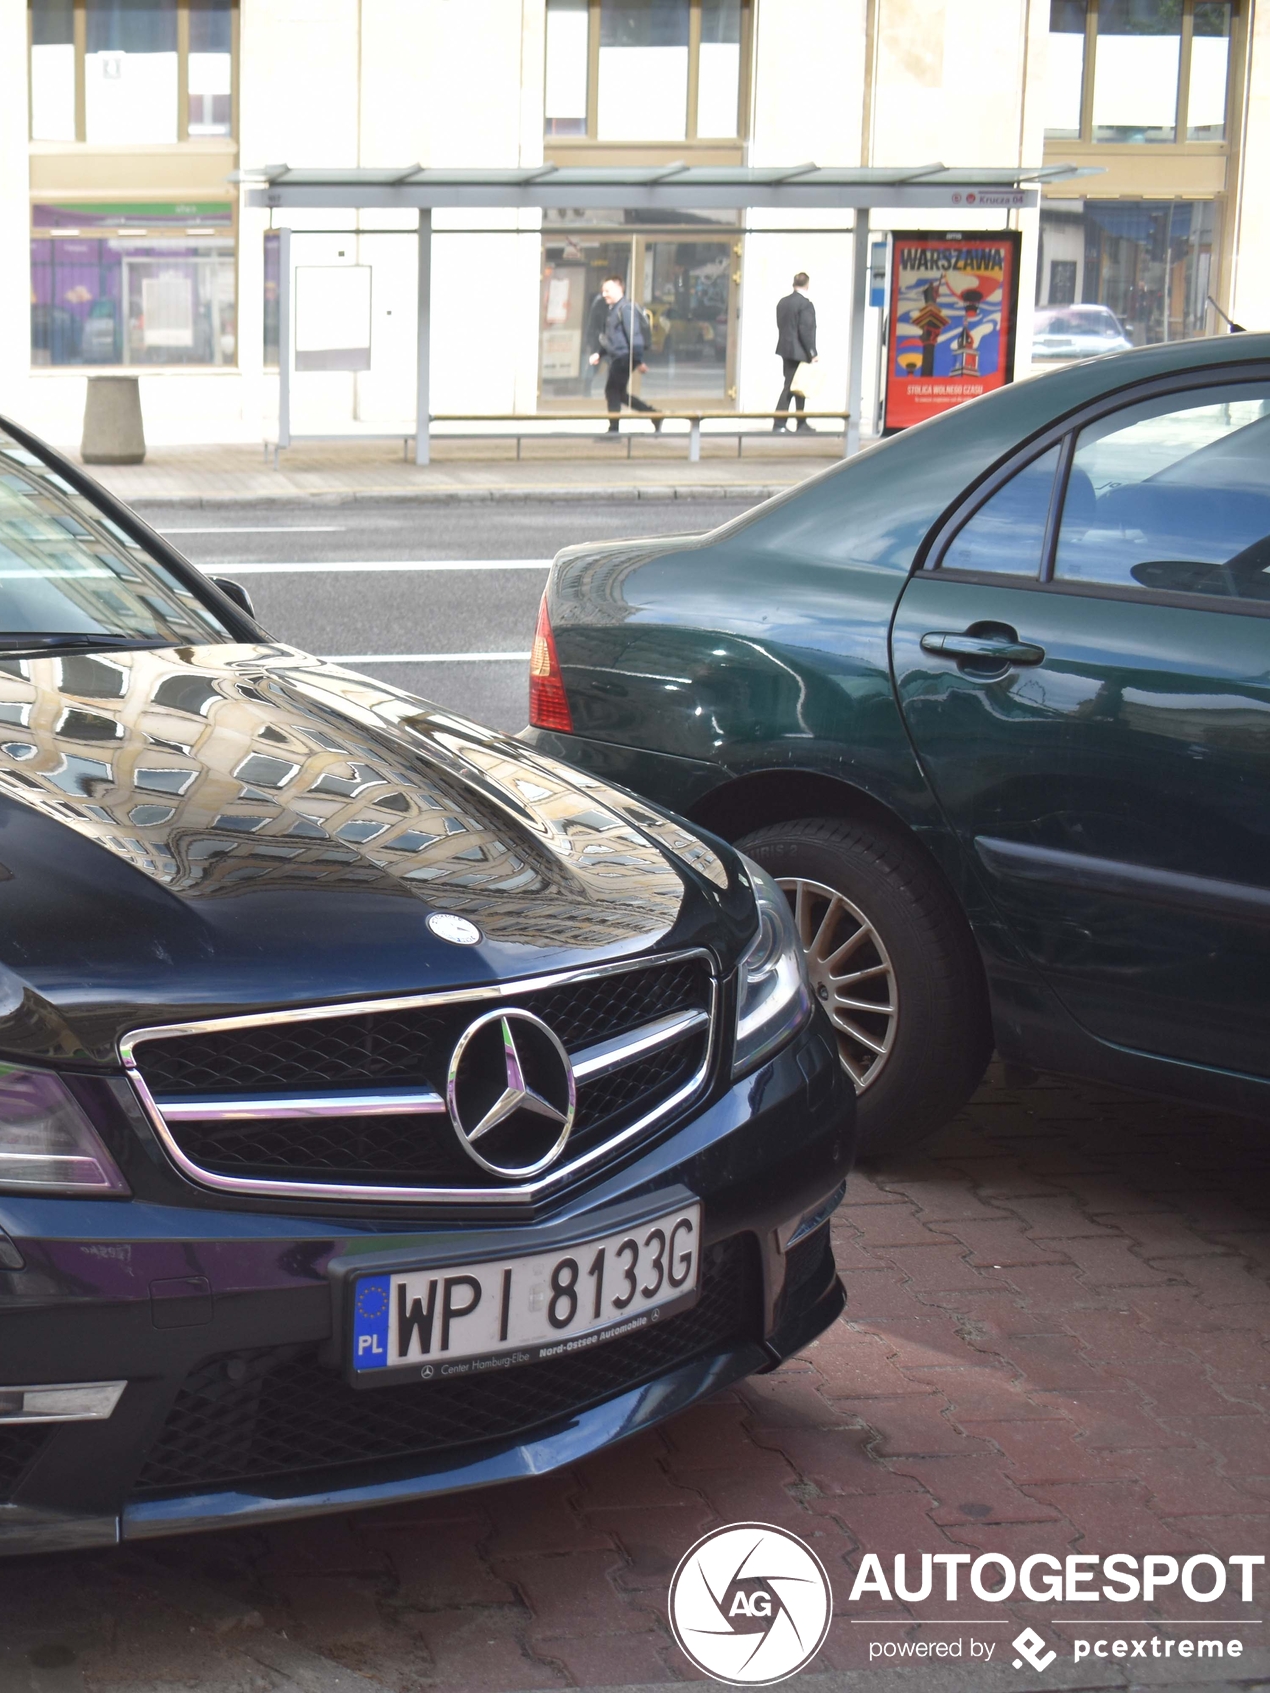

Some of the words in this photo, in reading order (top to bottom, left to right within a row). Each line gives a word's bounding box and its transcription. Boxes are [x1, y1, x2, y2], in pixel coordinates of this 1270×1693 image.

[979, 195, 1010, 204] Krucza
[900, 247, 1003, 271] WARSZAWA
[396, 1266, 513, 1358] WPI
[547, 1216, 694, 1330] 8133G
[357, 1334, 383, 1355] PL
[440, 1362, 470, 1376] Center
[472, 1352, 531, 1373] Hamburg-Elbe
[539, 1334, 598, 1358] Nord-Ostsee
[599, 1315, 648, 1342] Automobile
